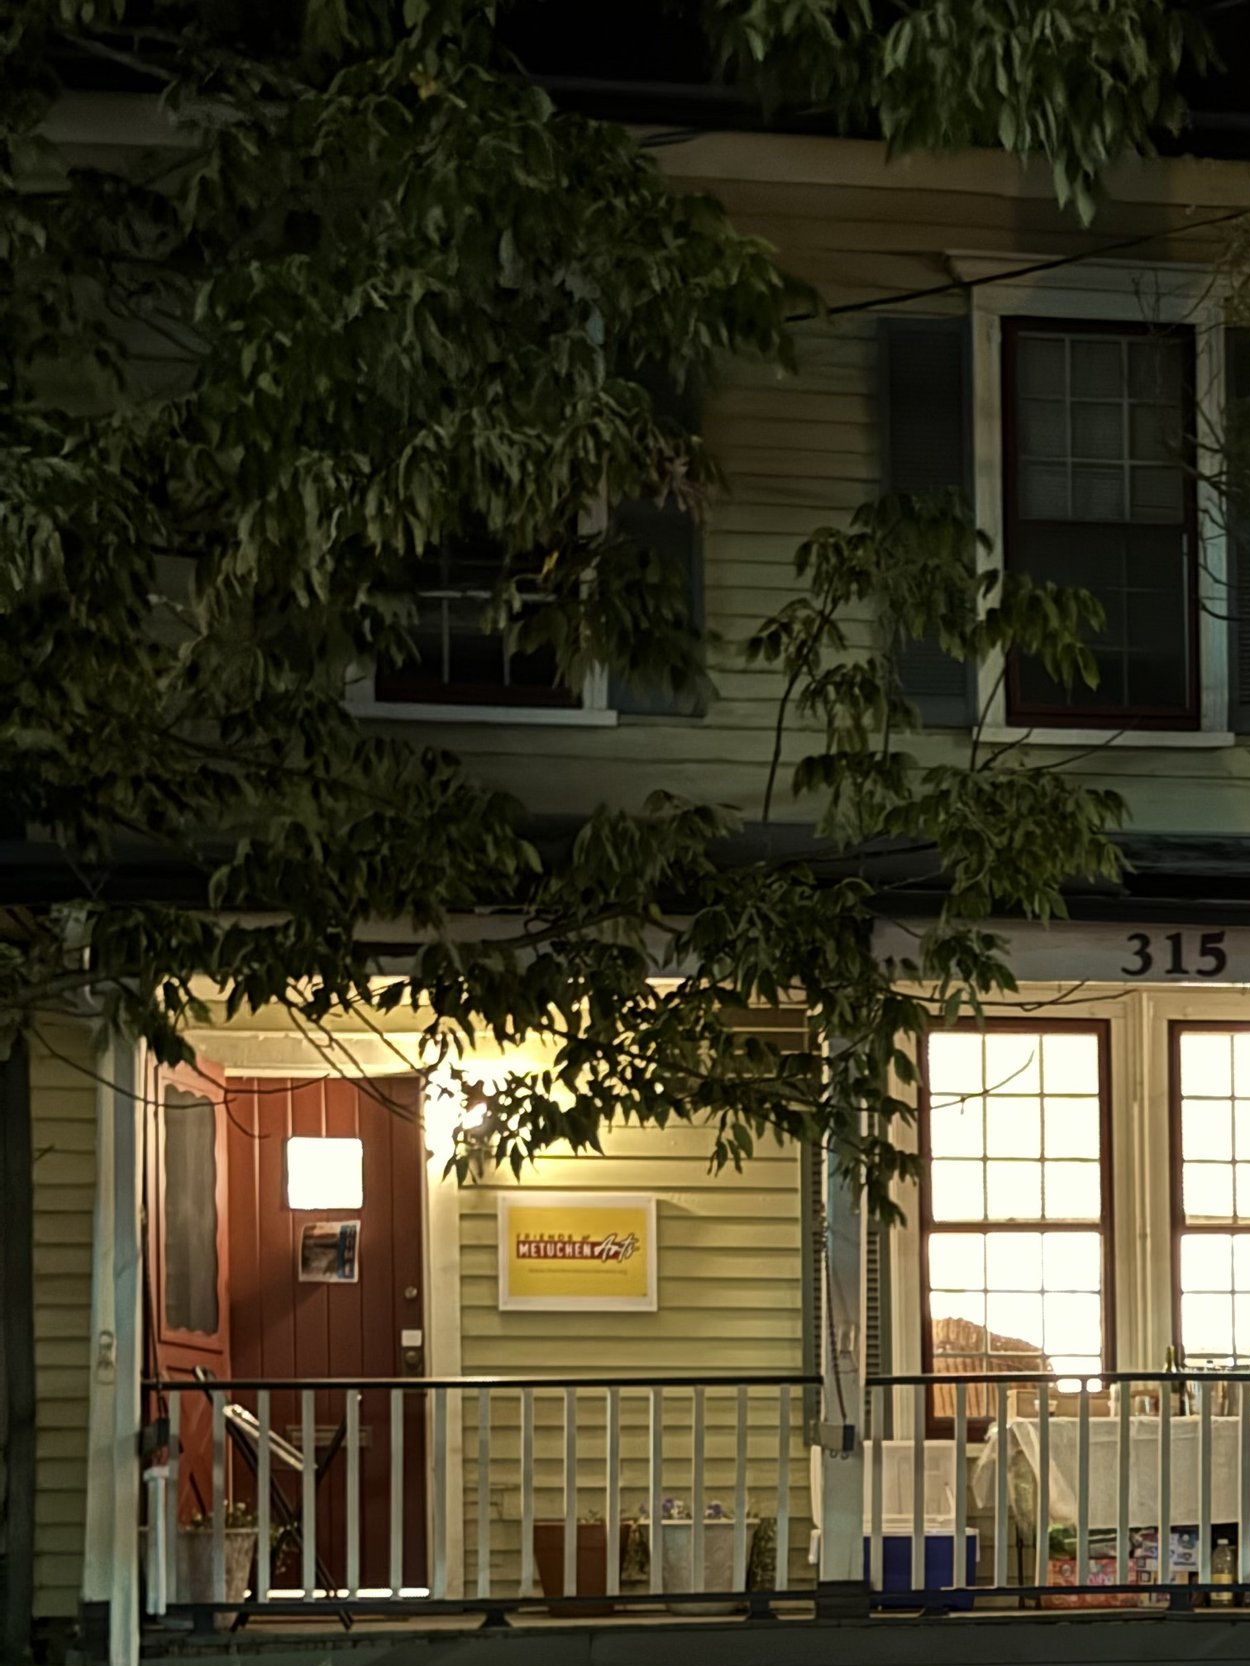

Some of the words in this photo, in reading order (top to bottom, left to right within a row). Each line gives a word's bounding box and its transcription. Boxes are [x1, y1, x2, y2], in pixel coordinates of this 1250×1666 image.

[1121, 930, 1227, 977] 315
[518, 1242, 592, 1257] METUCHEN
[594, 1232, 640, 1263] Arts
